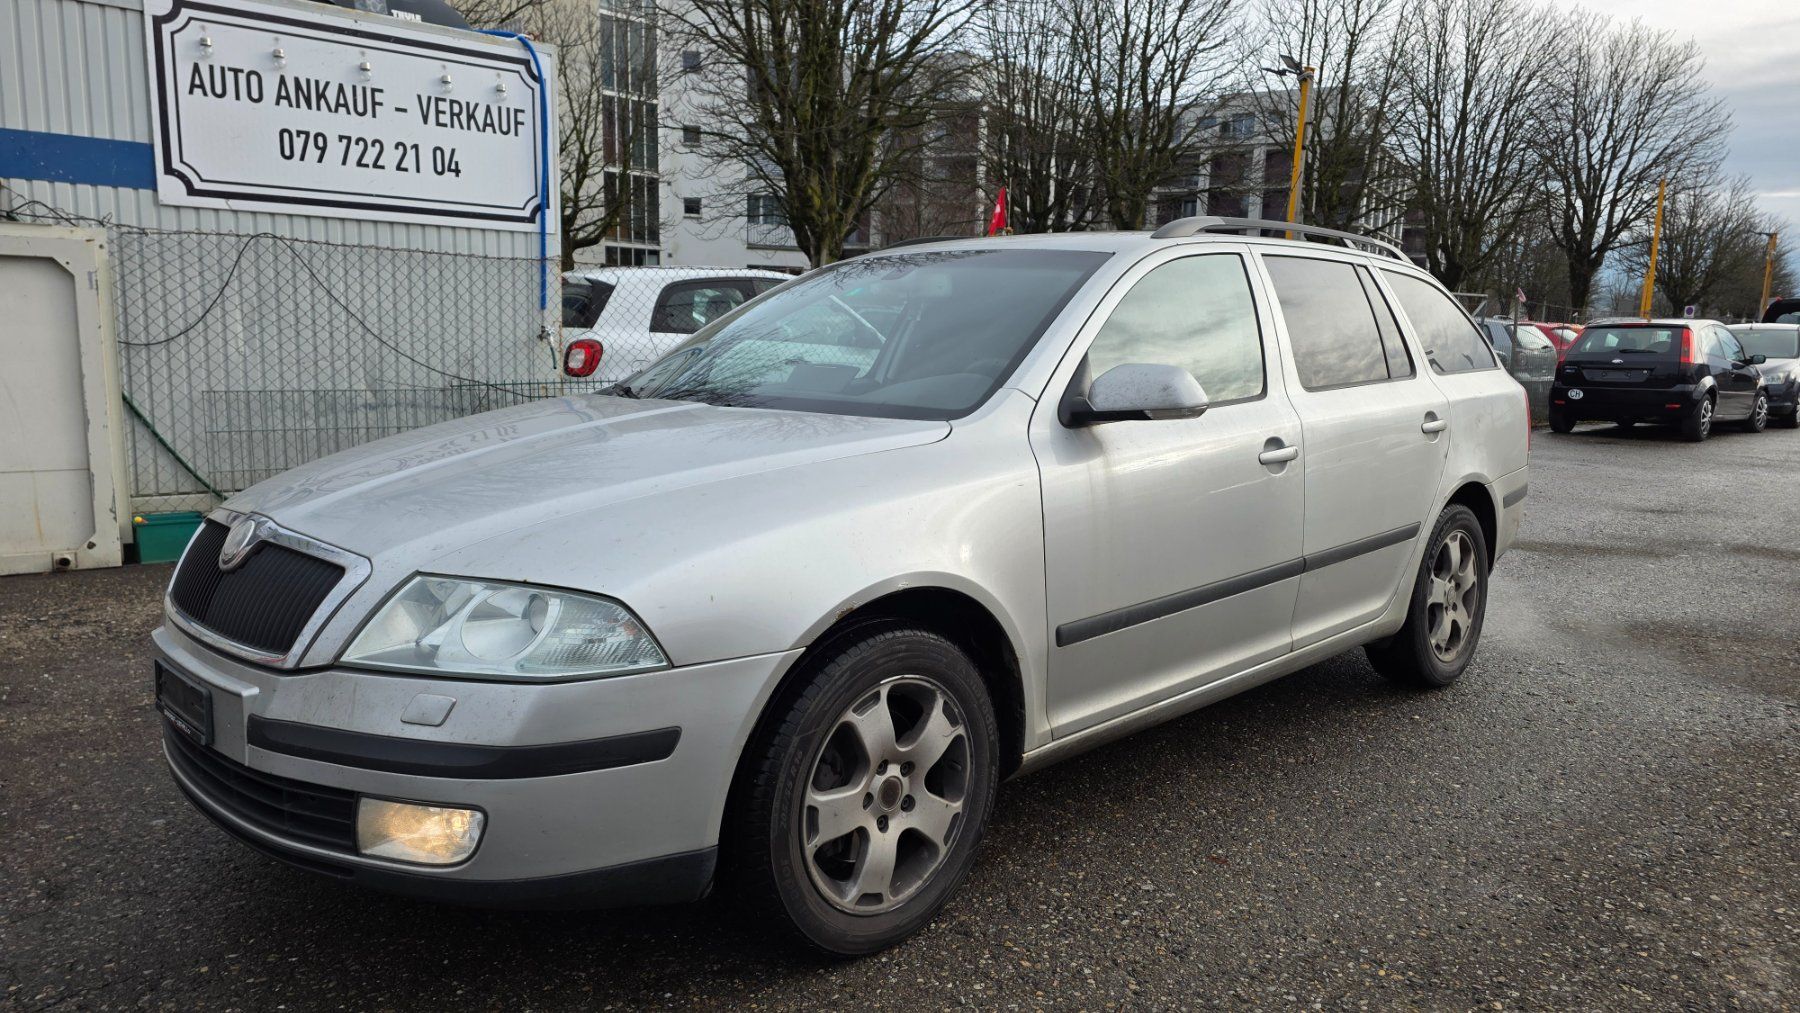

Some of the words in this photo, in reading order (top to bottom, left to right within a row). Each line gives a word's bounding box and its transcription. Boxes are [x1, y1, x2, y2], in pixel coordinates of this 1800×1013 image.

[188, 61, 264, 104] AUTO
[274, 74, 384, 119] ANKAUF
[416, 93, 526, 137] VERKAUF
[278, 127, 328, 164] 079
[337, 134, 386, 170] 722
[394, 141, 421, 174] 21
[432, 145, 462, 178] 04
[1569, 389, 1581, 399] CH
